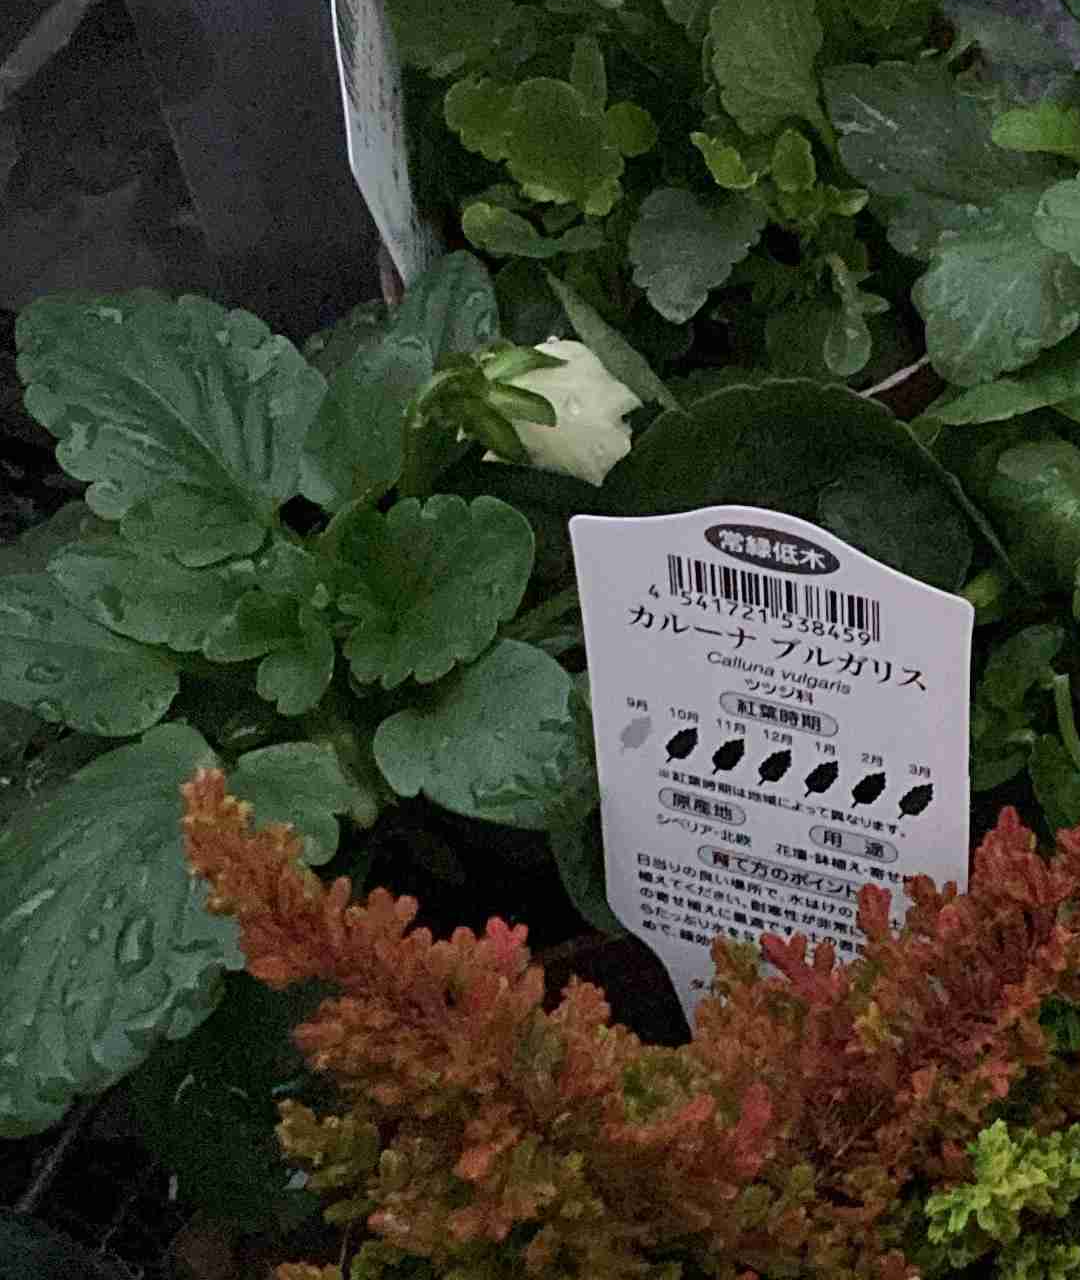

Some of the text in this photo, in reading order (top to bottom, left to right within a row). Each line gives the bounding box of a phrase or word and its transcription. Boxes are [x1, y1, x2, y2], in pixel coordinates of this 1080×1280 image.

[718, 529, 826, 571] 常緑低木
[648, 583, 871, 646] 4 541721 538459
[628, 605, 927, 691] カルーナ ブルガリス
[706, 651, 852, 695] Calluna vulgaris
[744, 677, 815, 705] ツツジ科
[626, 695, 932, 779] 9月 10月 11月 12月 1月 2月 3月
[737, 698, 822, 733] 紅葉時期
[672, 791, 733, 822] 原産地
